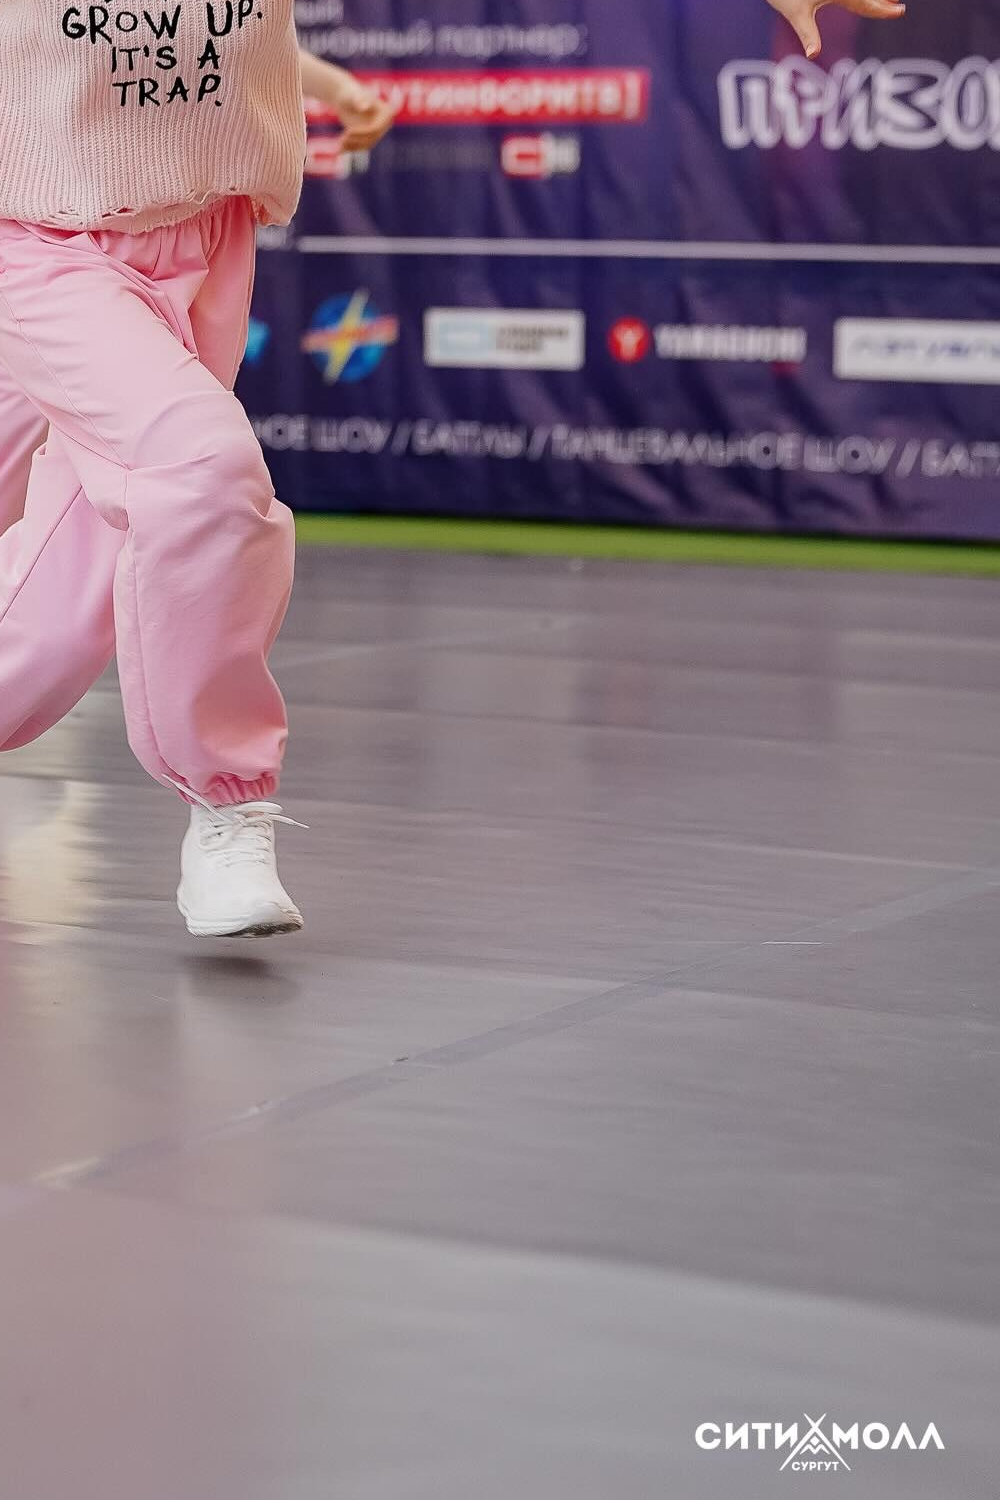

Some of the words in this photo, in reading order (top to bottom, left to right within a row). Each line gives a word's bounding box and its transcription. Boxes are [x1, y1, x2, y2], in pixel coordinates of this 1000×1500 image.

[62, 5, 181, 44] GROW
[112, 46, 178, 73] IT'S
[197, 38, 221, 70] A
[112, 74, 222, 107] TRAP.
[717, 54, 1000, 151] ПРИЗО
